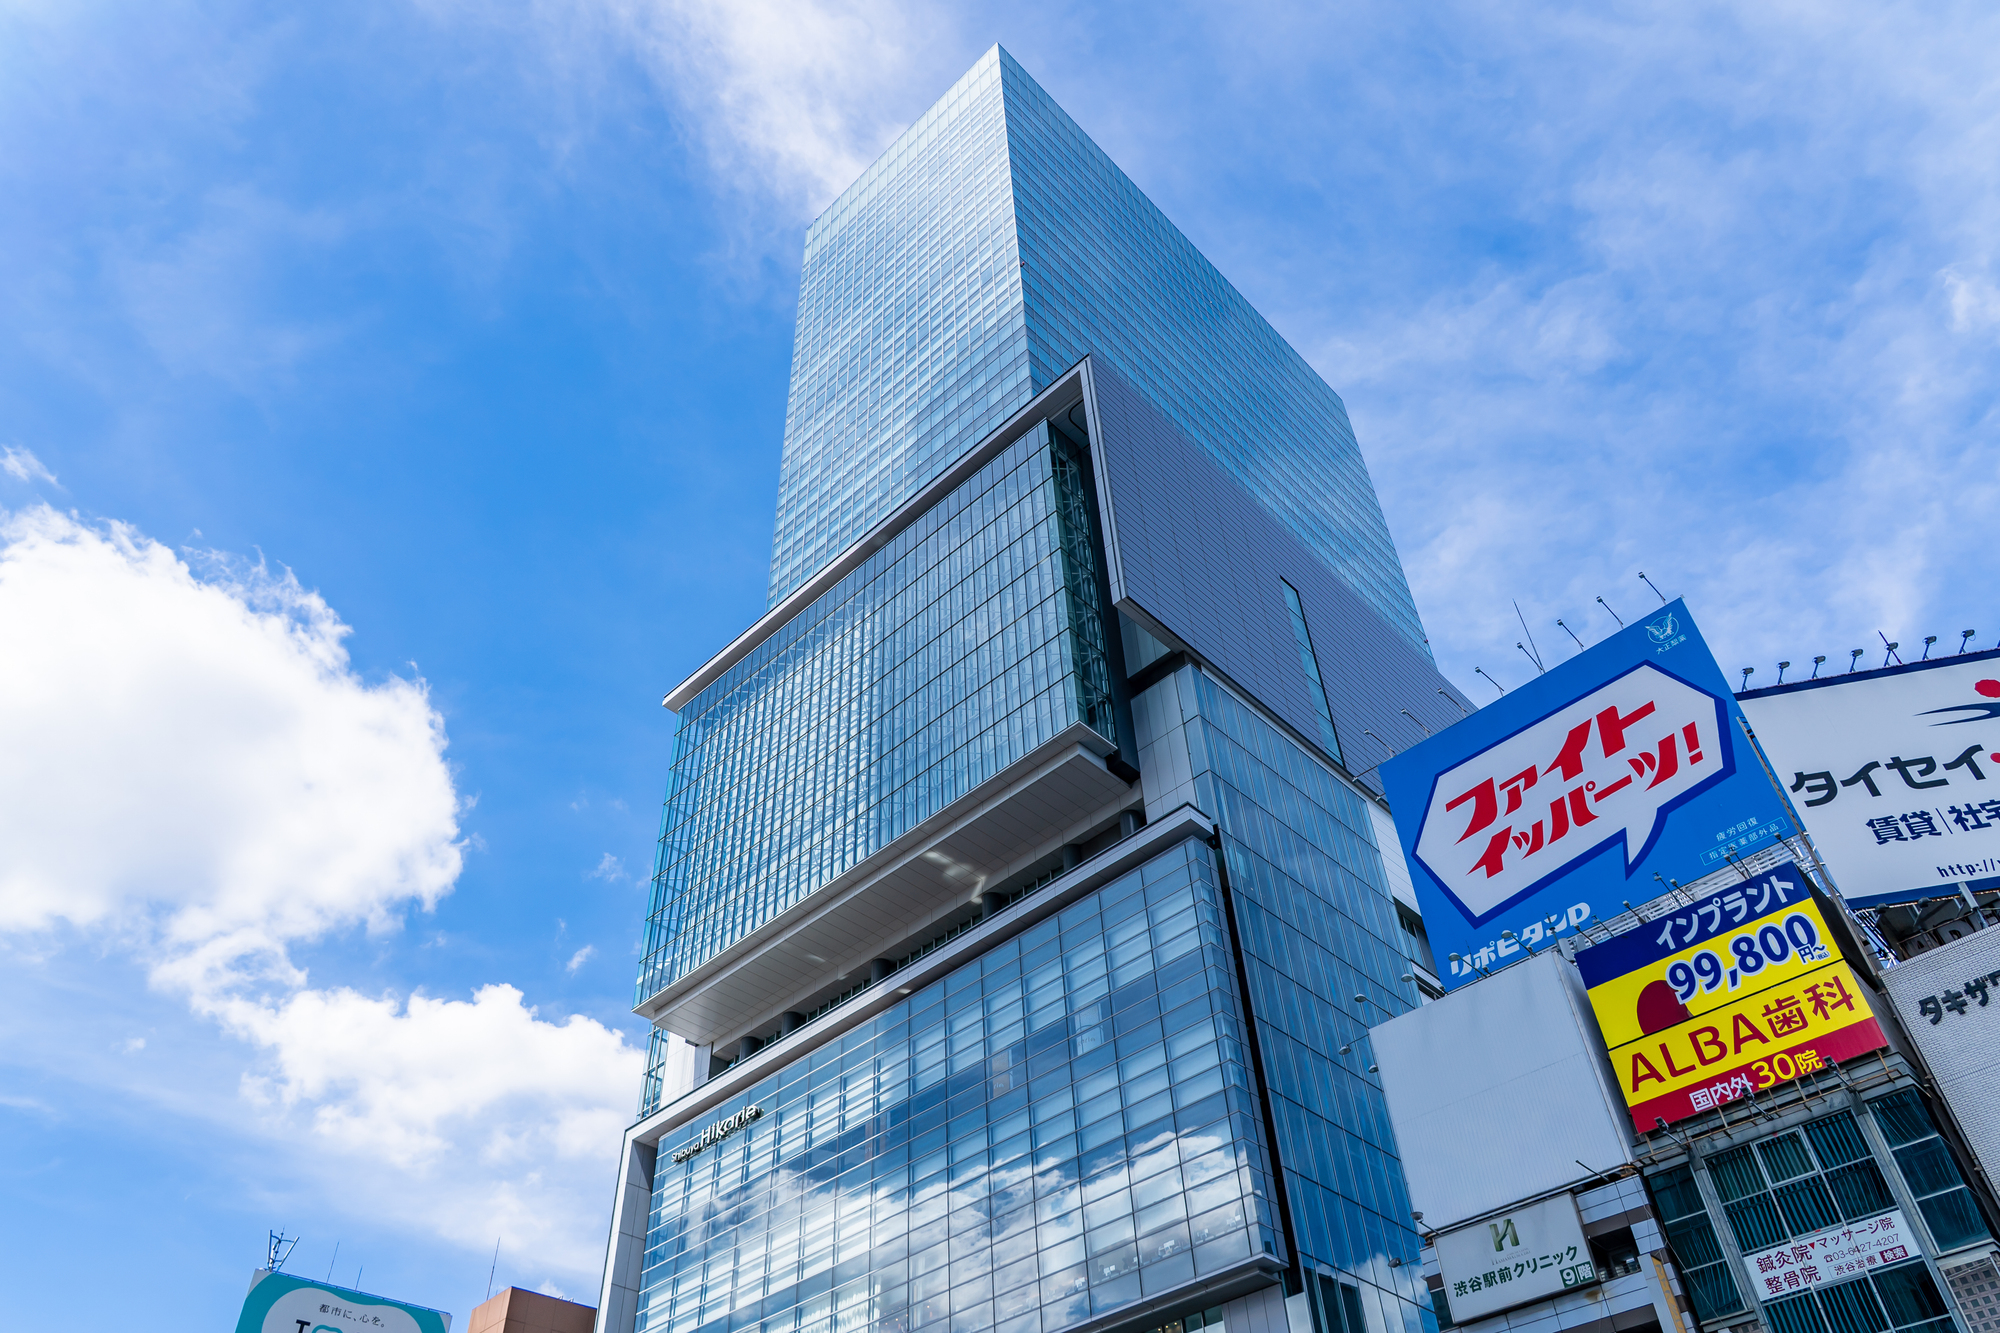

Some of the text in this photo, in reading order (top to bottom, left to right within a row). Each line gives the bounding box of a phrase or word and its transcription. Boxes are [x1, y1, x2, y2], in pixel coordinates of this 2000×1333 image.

[1445, 700, 1656, 846] ファイト
[1465, 721, 1704, 879] イッパーツ!
[1716, 816, 1759, 842] 疲労回復
[1655, 875, 1794, 950] インプラント
[1450, 902, 1591, 978] リポビタンD
[700, 1105, 760, 1148] Hikarie
[1816, 1216, 1895, 1249] マッサージ院
[1756, 1244, 1812, 1274] 鍼灸院
[1833, 1255, 1878, 1276] 渋谷治療
[1883, 1246, 1906, 1262] 検索
[1453, 1245, 1578, 1298] 渋谷駅前クリニック
[1562, 1263, 1593, 1285] 9階
[1764, 1265, 1822, 1295] 整骨院
[319, 1303, 385, 1328] 都市に、心を。
